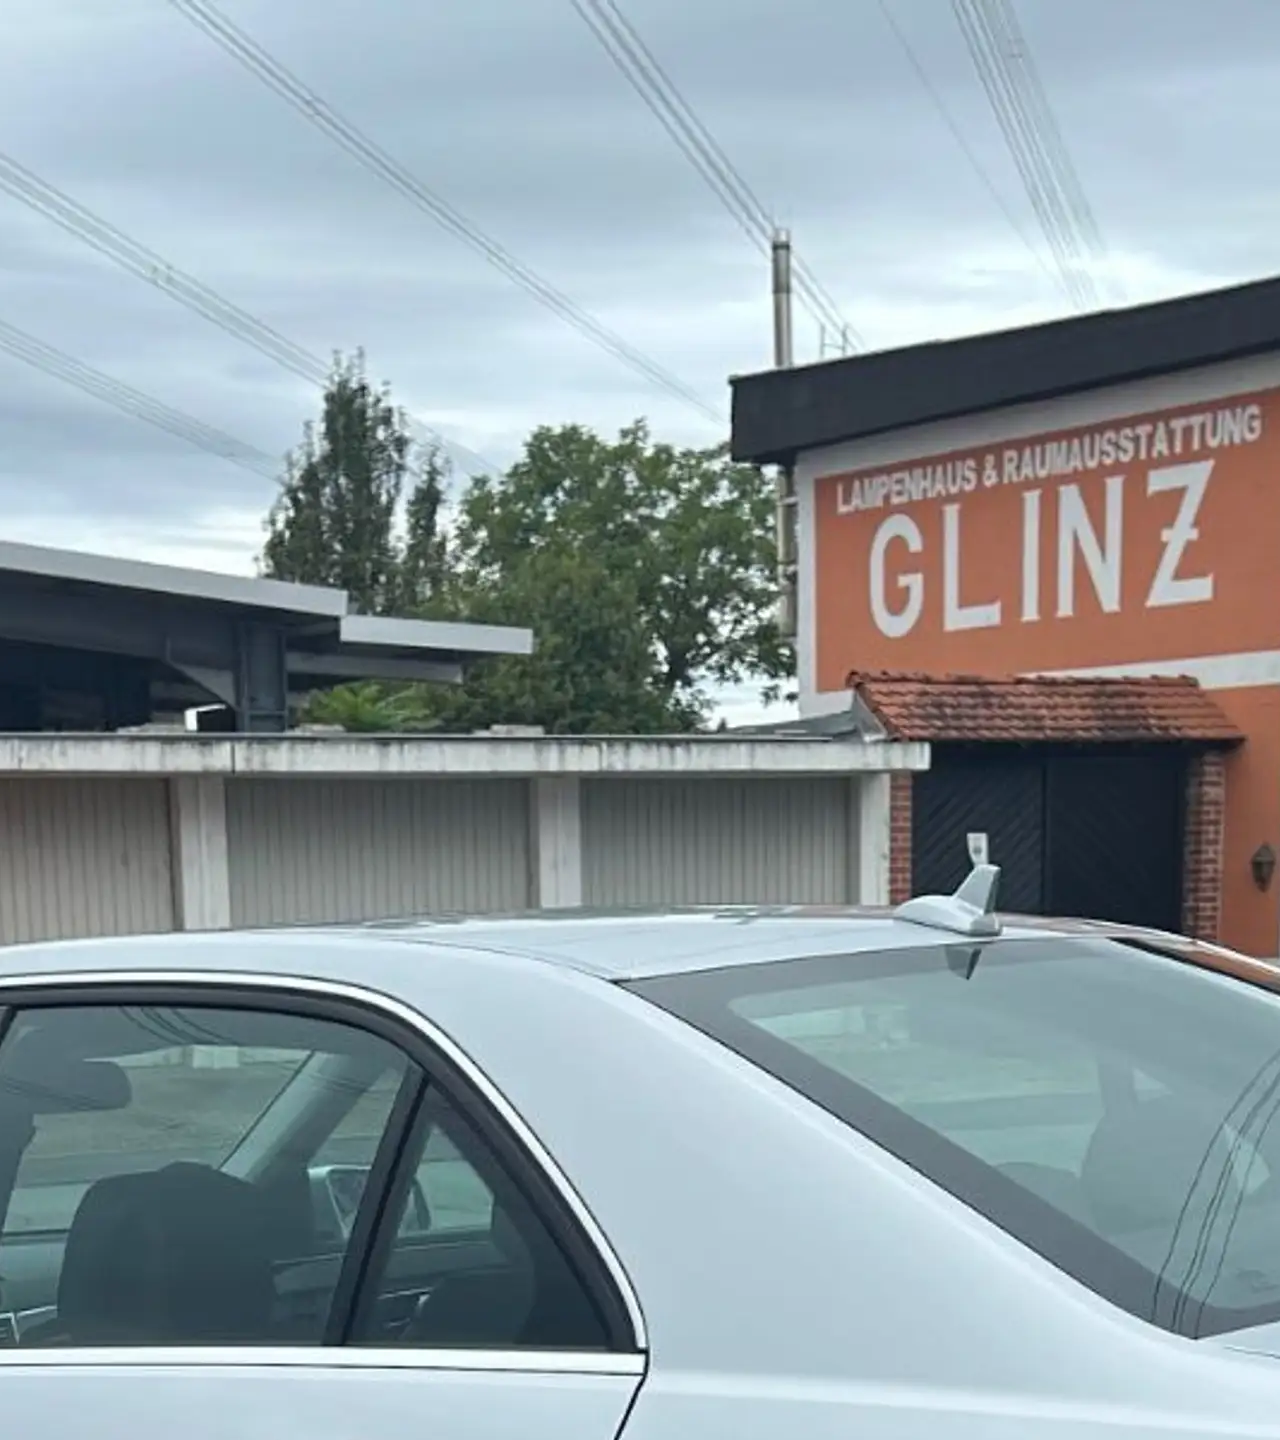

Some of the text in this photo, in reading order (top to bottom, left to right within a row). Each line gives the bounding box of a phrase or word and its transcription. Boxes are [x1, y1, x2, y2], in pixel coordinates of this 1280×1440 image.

[836, 404, 1262, 515] LAMPENHAUS & RAUMAUSSTATTUNG
[869, 458, 1215, 638] GLINZ
